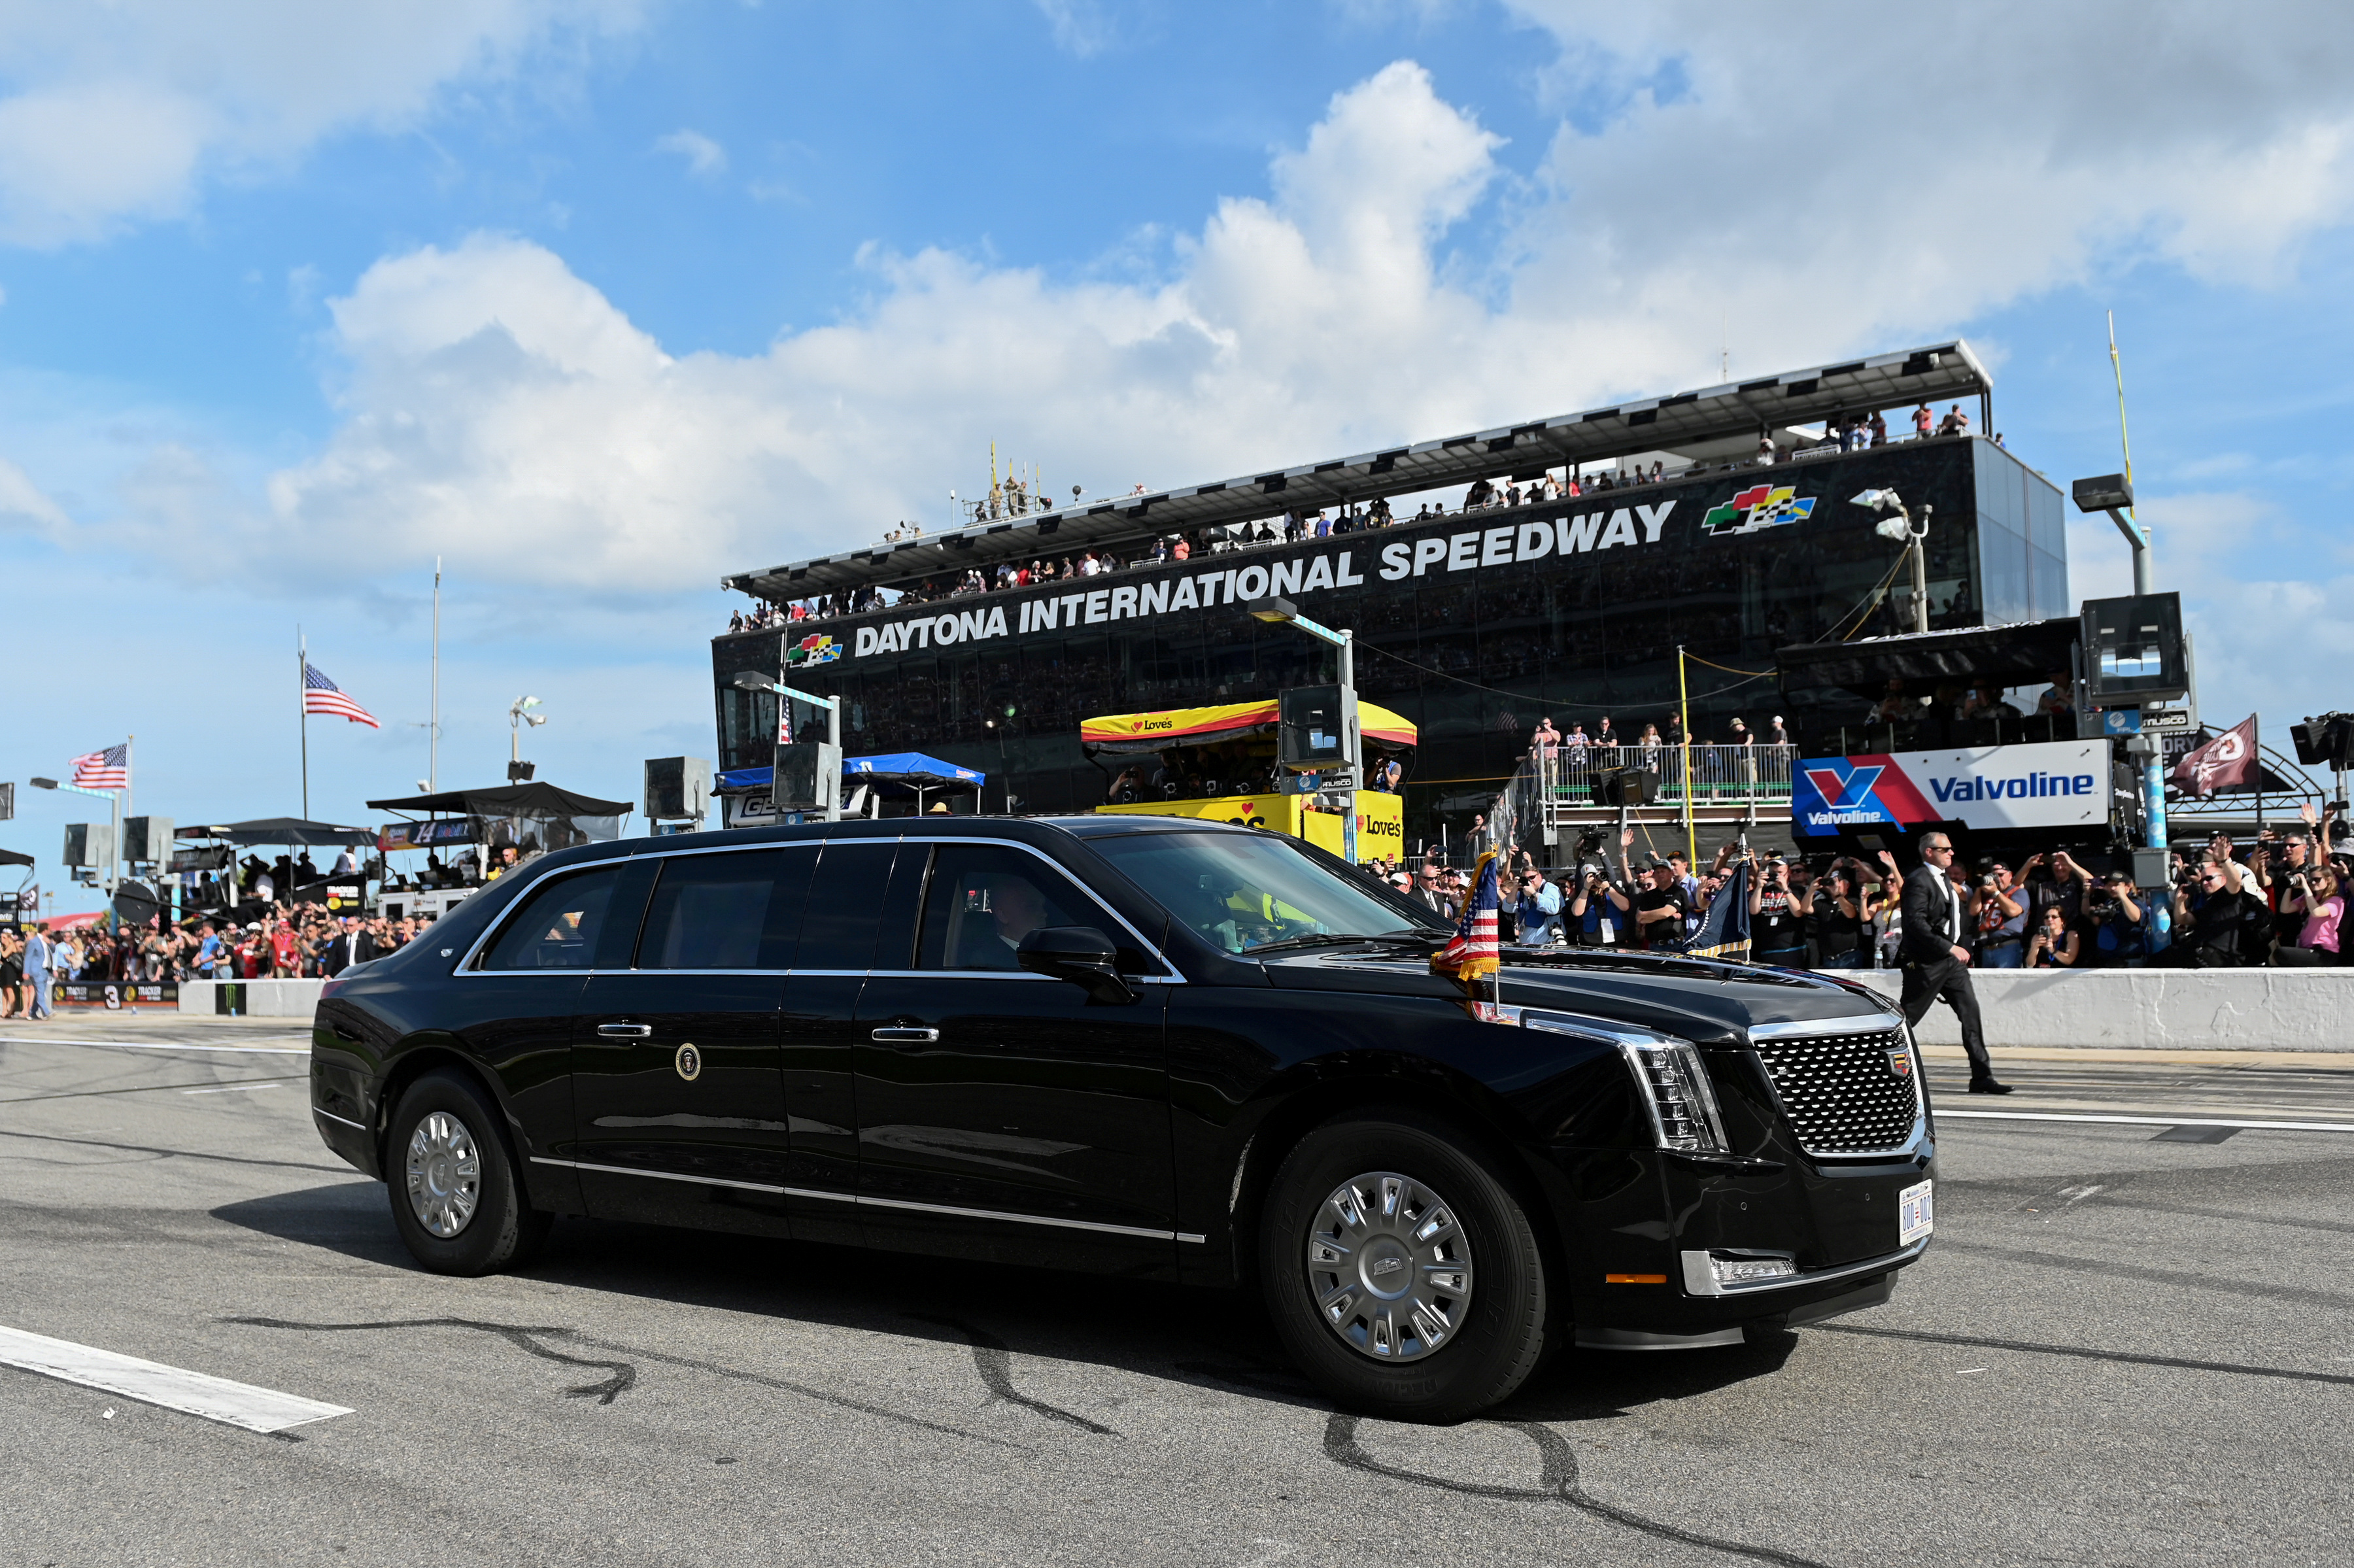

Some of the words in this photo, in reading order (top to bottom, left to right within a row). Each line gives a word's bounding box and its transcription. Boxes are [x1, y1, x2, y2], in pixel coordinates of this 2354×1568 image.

[855, 605, 1008, 658] DAYTONA
[1019, 551, 1364, 634] INTERNATIONAL
[1378, 500, 1678, 581] SPEEDWAY
[1929, 772, 2094, 802] Valvoline
[1807, 810, 1881, 825] Valvoline
[413, 822, 436, 844] 14
[104, 985, 120, 1009] 3
[1902, 1202, 1915, 1232] 800
[1920, 1195, 1931, 1223] 002
